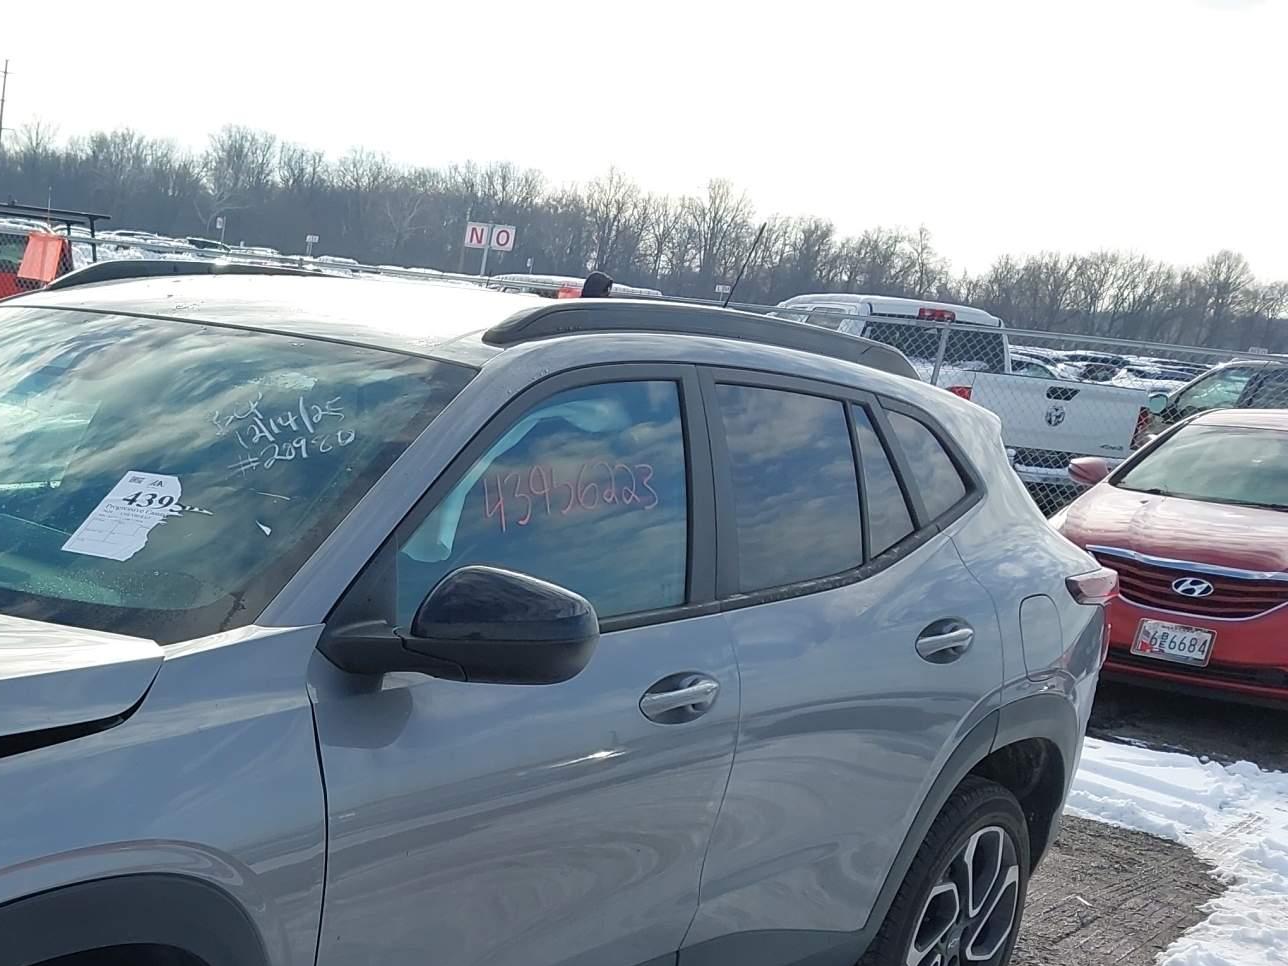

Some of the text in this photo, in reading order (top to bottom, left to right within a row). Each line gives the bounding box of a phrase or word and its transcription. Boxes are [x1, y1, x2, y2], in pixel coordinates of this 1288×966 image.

[469, 226, 510, 247] N O
[483, 460, 659, 533] 43956223
